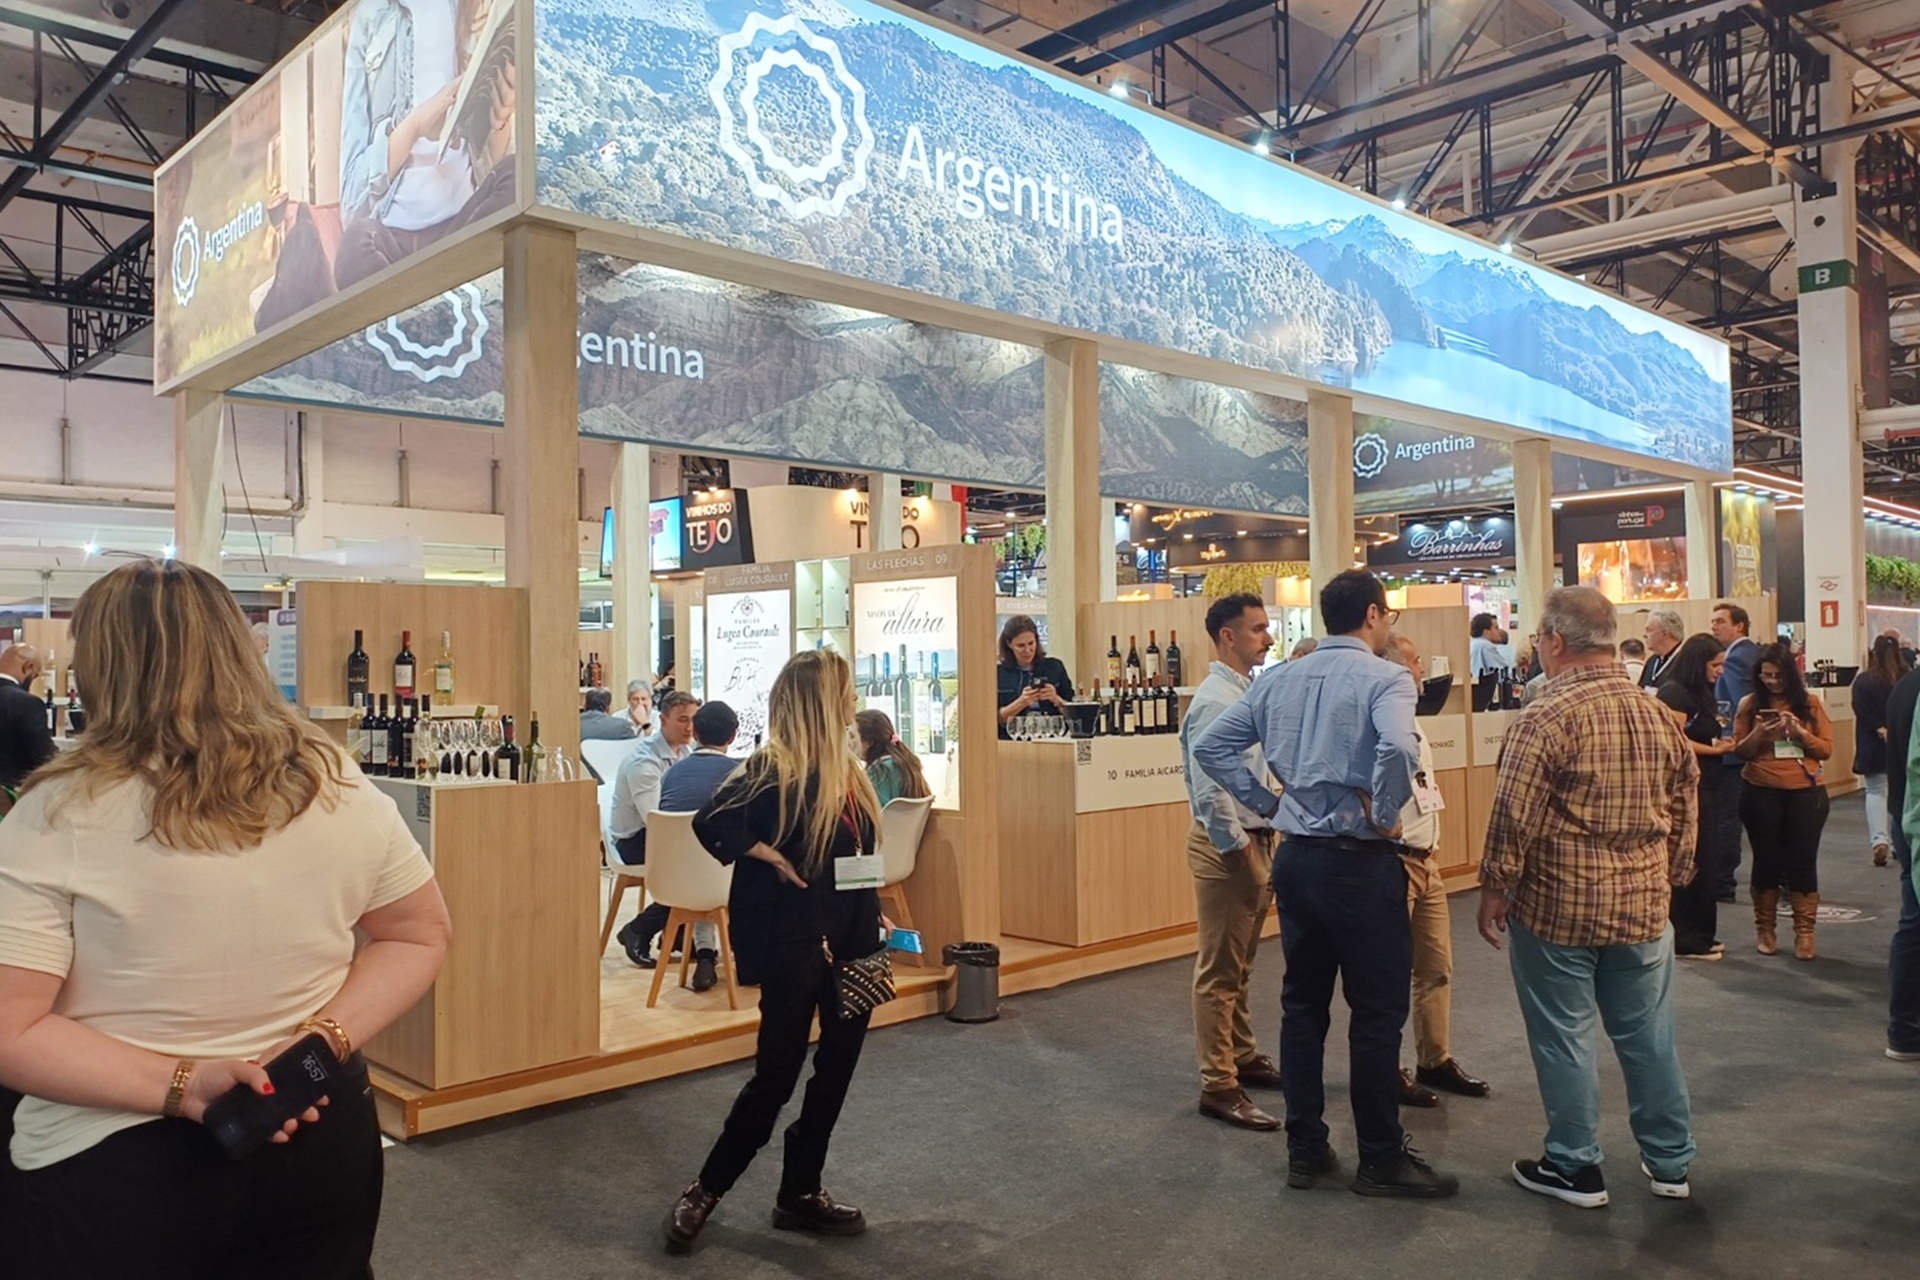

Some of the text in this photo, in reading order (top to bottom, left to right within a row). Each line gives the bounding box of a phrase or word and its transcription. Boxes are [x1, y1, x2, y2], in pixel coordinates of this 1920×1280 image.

[898, 125, 1123, 246] Argentina
[203, 200, 263, 262] Argentina
[1814, 268, 1831, 285] B
[577, 331, 704, 380] entina
[1394, 434, 1475, 461] Argentina
[685, 501, 732, 518] VINHOS DO
[850, 501, 920, 521] VIN DO
[685, 518, 732, 553] TEJO
[1407, 529, 1503, 557] Barrinhas
[741, 564, 772, 575] FAMILIA
[866, 553, 948, 571] LAS FLECHAS 09
[725, 575, 749, 586] LUGEA
[749, 572, 789, 584] COURAULT
[1107, 765, 1185, 781] 10 FAMILIA AICARD
[301, 1054, 326, 1082] 16:57
